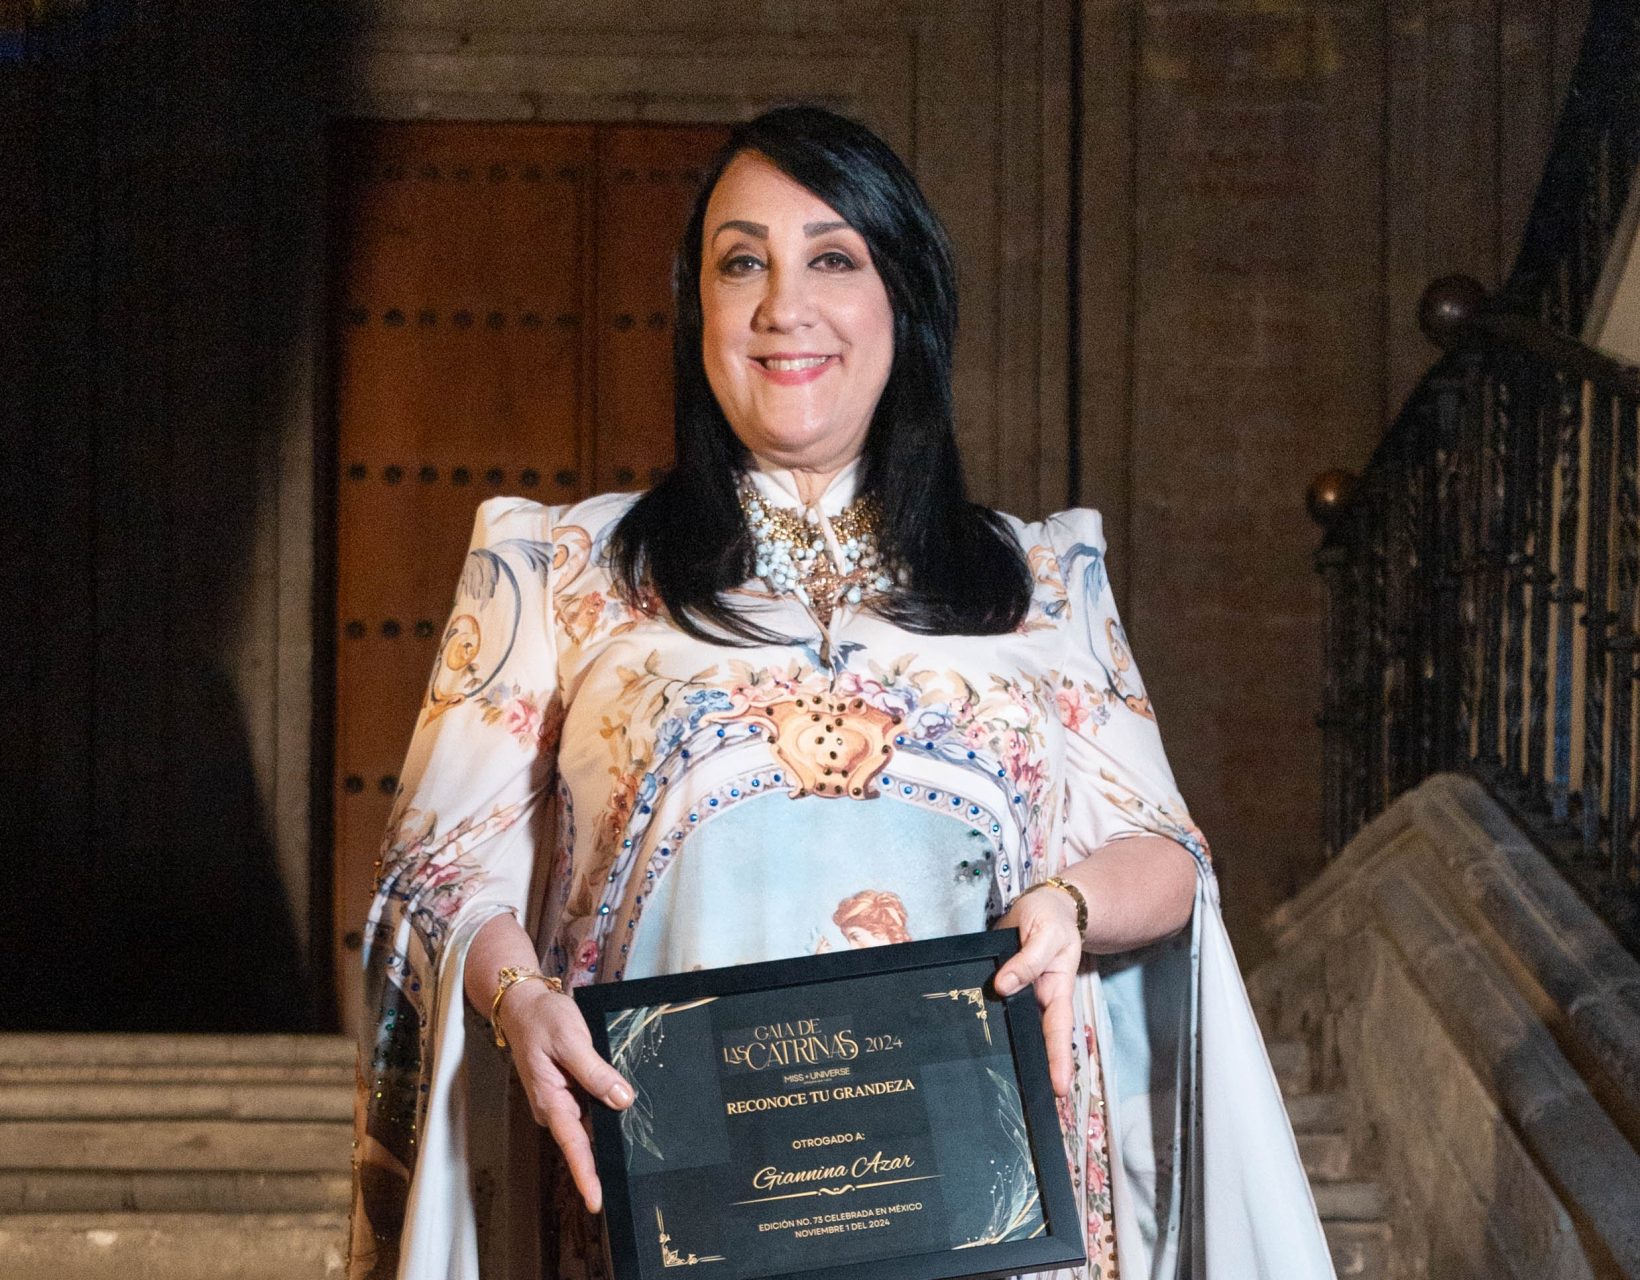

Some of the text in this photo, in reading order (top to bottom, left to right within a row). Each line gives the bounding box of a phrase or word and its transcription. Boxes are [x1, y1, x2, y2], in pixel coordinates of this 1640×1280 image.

[799, 1018, 822, 1035] DE
[723, 1030, 903, 1070] LAS CATRINAS 2024
[784, 1073, 804, 1083] MISS
[809, 1067, 851, 1080] UNIVERSE
[727, 1079, 915, 1114] RECONOCE TU GRANDEZA
[792, 1133, 866, 1149] OTROGADO A:
[753, 1151, 915, 1190] Giannina Azar
[759, 1219, 795, 1232] EDICIÓN
[797, 1217, 812, 1227] NO.
[813, 1216, 824, 1224] 73
[824, 1209, 874, 1223] CELEBRADA
[888, 1202, 923, 1214] MÉXICO
[795, 1225, 845, 1238] NOVIEMBRE
[851, 1223, 867, 1231] DEL
[869, 1219, 890, 1229] 2024
